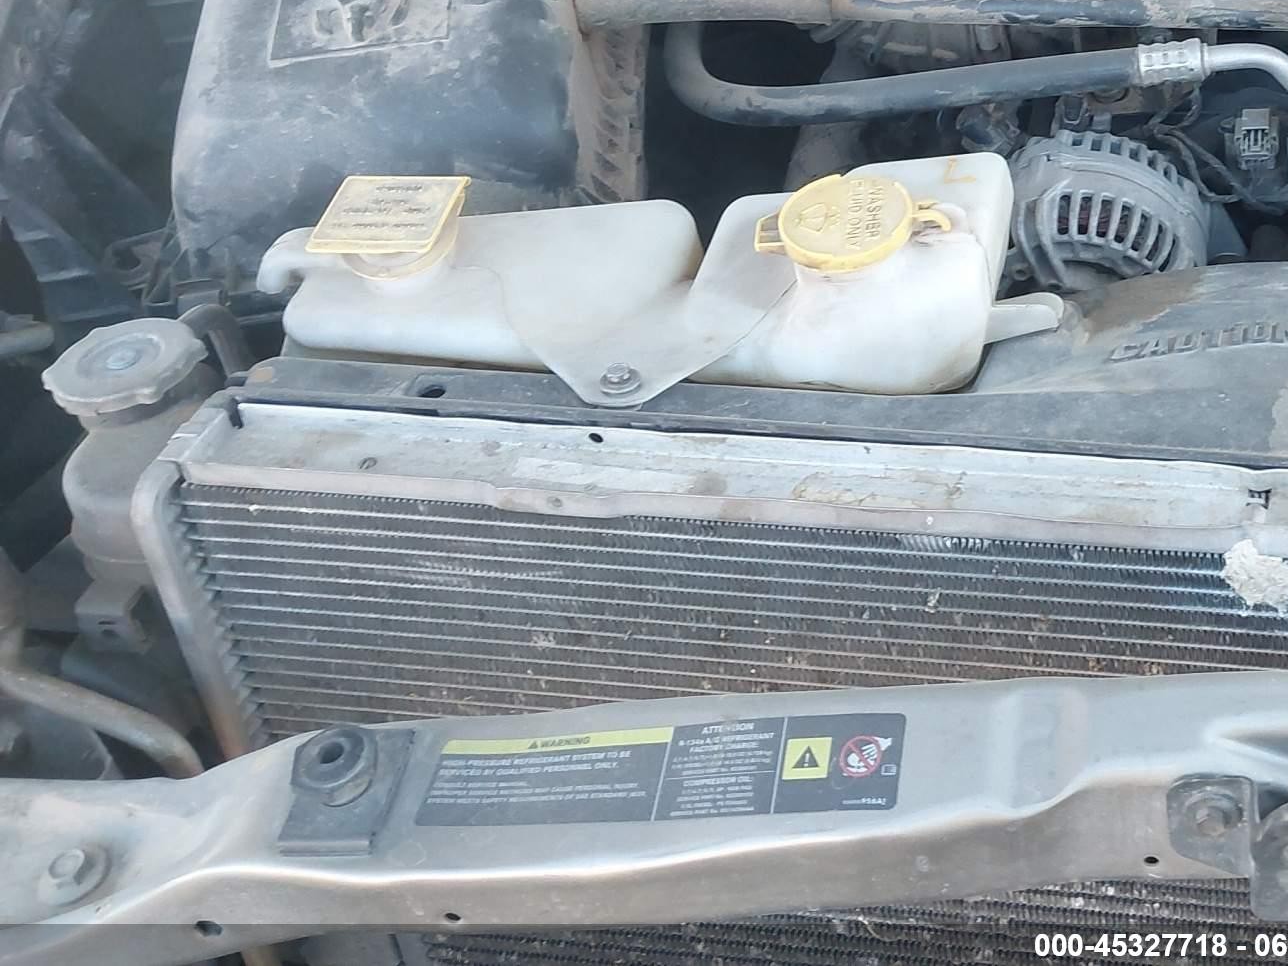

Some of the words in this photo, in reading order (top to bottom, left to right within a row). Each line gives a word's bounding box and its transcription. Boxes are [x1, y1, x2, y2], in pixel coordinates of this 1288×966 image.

[848, 179, 865, 216] FLUID
[845, 217, 862, 251] ONLY
[540, 736, 591, 748] WARNING
